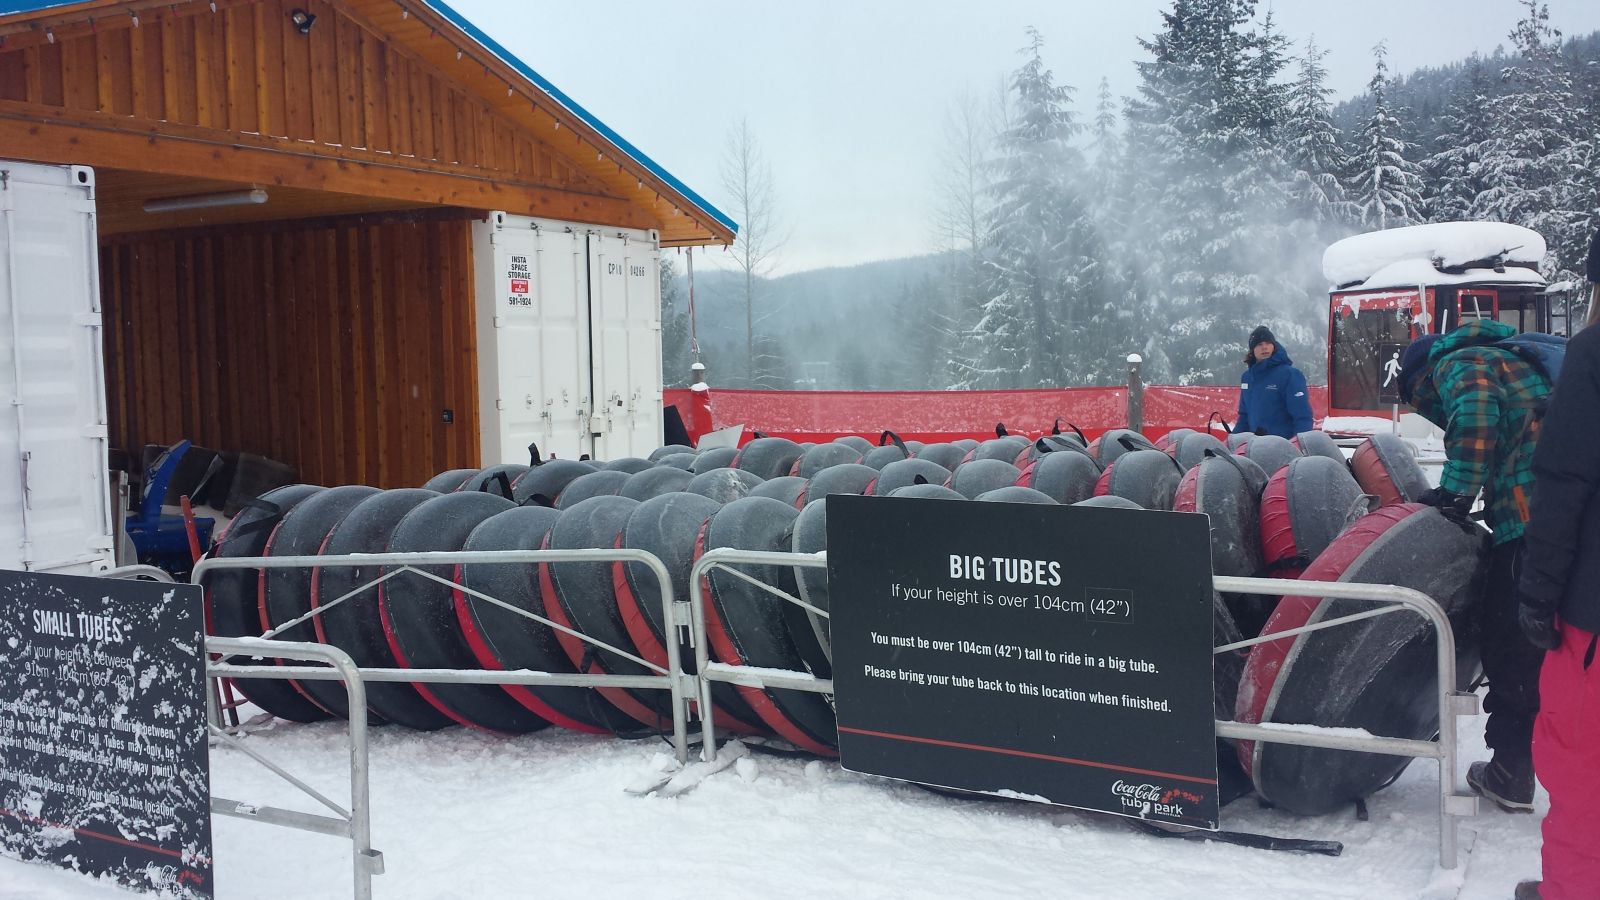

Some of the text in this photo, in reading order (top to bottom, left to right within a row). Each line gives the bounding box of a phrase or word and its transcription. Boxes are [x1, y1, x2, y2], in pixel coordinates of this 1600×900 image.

[508, 271, 531, 279] STORAGE
[511, 263, 528, 271] SPACE
[509, 297, 532, 306] 581-1924
[950, 554, 1062, 586] BIG TUBES
[891, 583, 900, 597] If
[903, 586, 932, 600] your
[937, 587, 979, 605] height
[983, 591, 994, 605] is
[998, 595, 1028, 608] over
[1034, 595, 1085, 613] 104cm
[33, 609, 122, 643] SMALL TUBES
[34, 646, 52, 661] your
[54, 645, 81, 667] height
[94, 652, 132, 669] between
[871, 631, 888, 645] You
[891, 636, 915, 648] must
[918, 637, 930, 649] be
[932, 640, 954, 652] over
[958, 640, 992, 656] 104cm
[1025, 648, 1042, 661] tall
[1045, 650, 1056, 662] to
[1059, 652, 1081, 665] ride
[1084, 654, 1095, 667] in
[1098, 657, 1105, 668] a
[1108, 656, 1126, 672] big
[1129, 659, 1159, 674] tube.
[25, 661, 49, 679] 91cm
[58, 665, 88, 685] 104cm
[864, 664, 1172, 713] Please bring your tube back to this location when finished.
[78, 712, 96, 727] tubes
[98, 714, 108, 728] for
[142, 722, 174, 739] between
[16, 736, 22, 748] in
[26, 720, 47, 736] 104cm
[104, 734, 124, 750] Tubes
[127, 740, 142, 756] may
[146, 744, 162, 759] only
[165, 745, 175, 759] be
[121, 795, 129, 807] to
[130, 796, 143, 810] this
[1154, 803, 1184, 815] park
